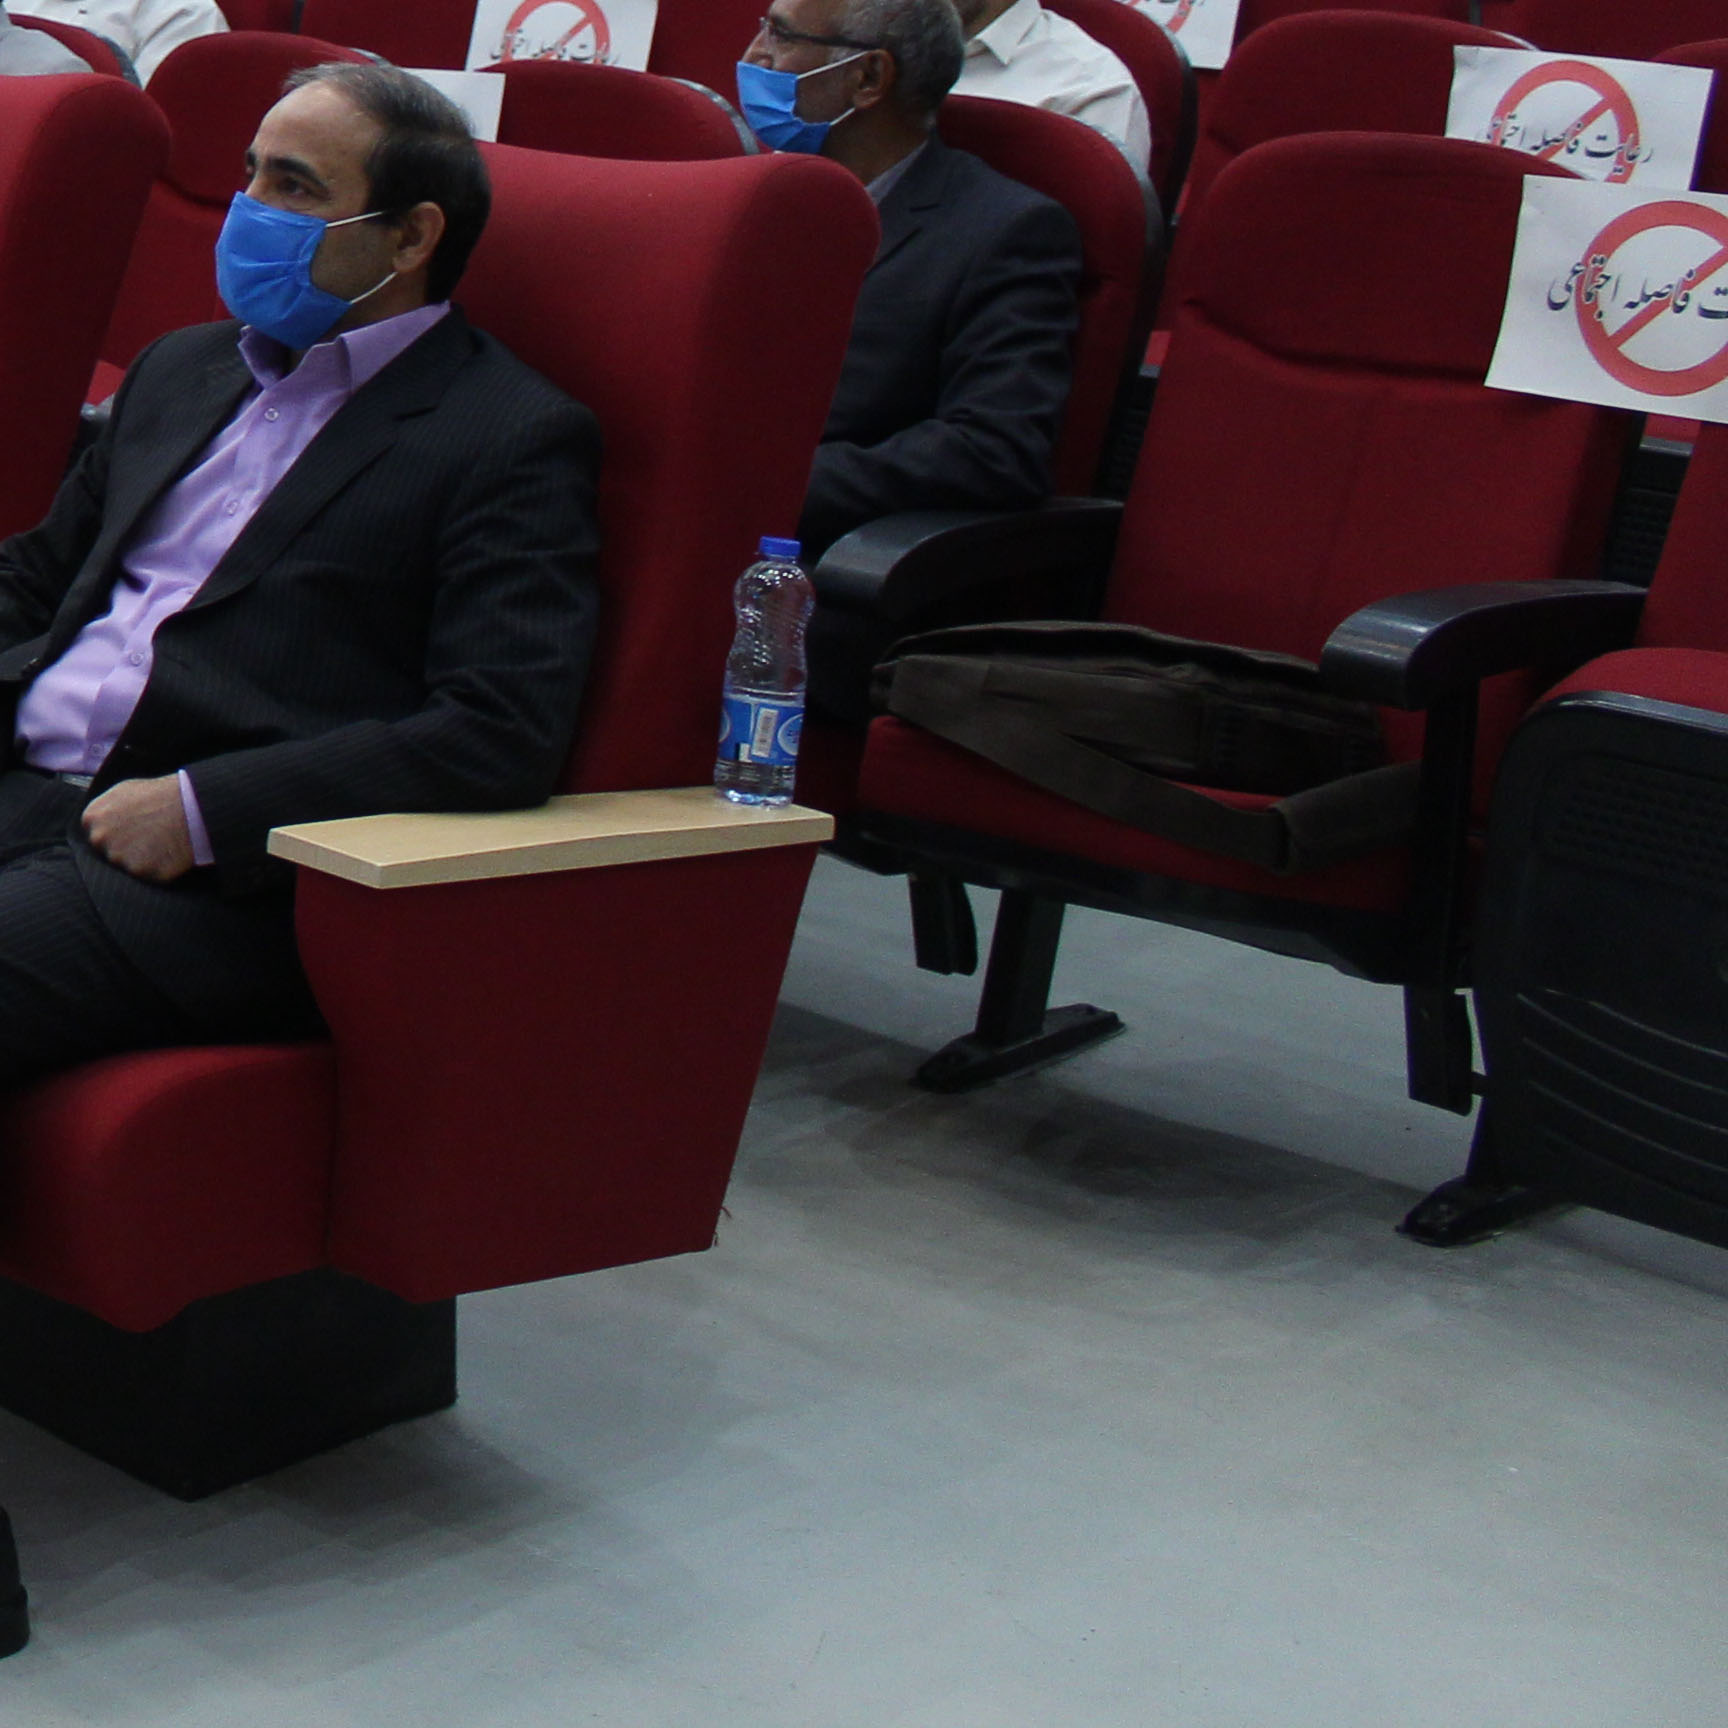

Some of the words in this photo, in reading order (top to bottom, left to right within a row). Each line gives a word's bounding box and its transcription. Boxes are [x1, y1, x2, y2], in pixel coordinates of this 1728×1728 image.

[1529, 122, 1583, 155] فاصله
[1585, 133, 1654, 173] رعایت
[1547, 254, 1621, 322] اجتماعی
[1623, 268, 1695, 313] فاصله
